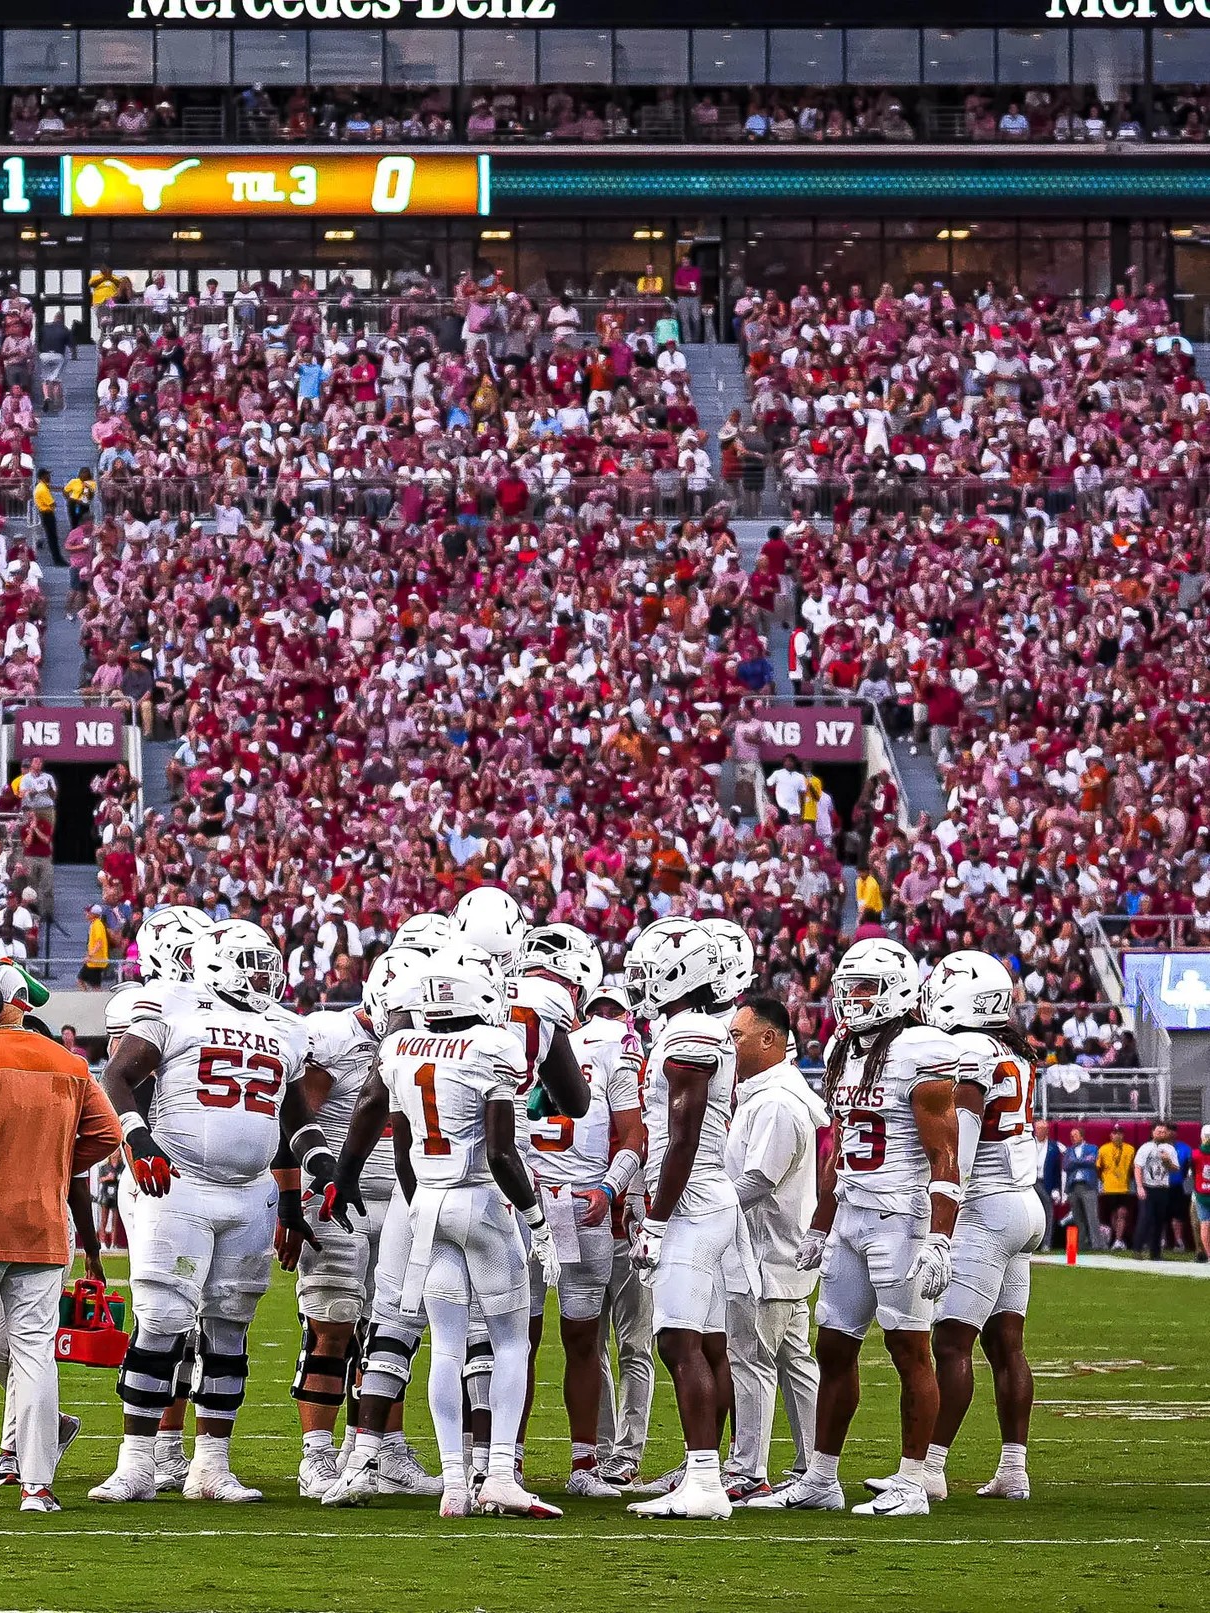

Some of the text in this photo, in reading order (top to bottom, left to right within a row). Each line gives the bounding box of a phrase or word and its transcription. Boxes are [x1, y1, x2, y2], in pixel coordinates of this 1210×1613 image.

[2, 157, 30, 212] 1
[225, 166, 318, 206] TOL 3
[371, 157, 416, 212] 0
[22, 720, 114, 747] N5 N6
[763, 720, 855, 747] N6 N7
[205, 1027, 280, 1056] TEXAS
[396, 1036, 474, 1060] WORTHY
[197, 1047, 284, 1117] 52
[835, 1086, 885, 1107] EXAS
[414, 1063, 451, 1155] 1
[58, 1334, 72, 1356] G
